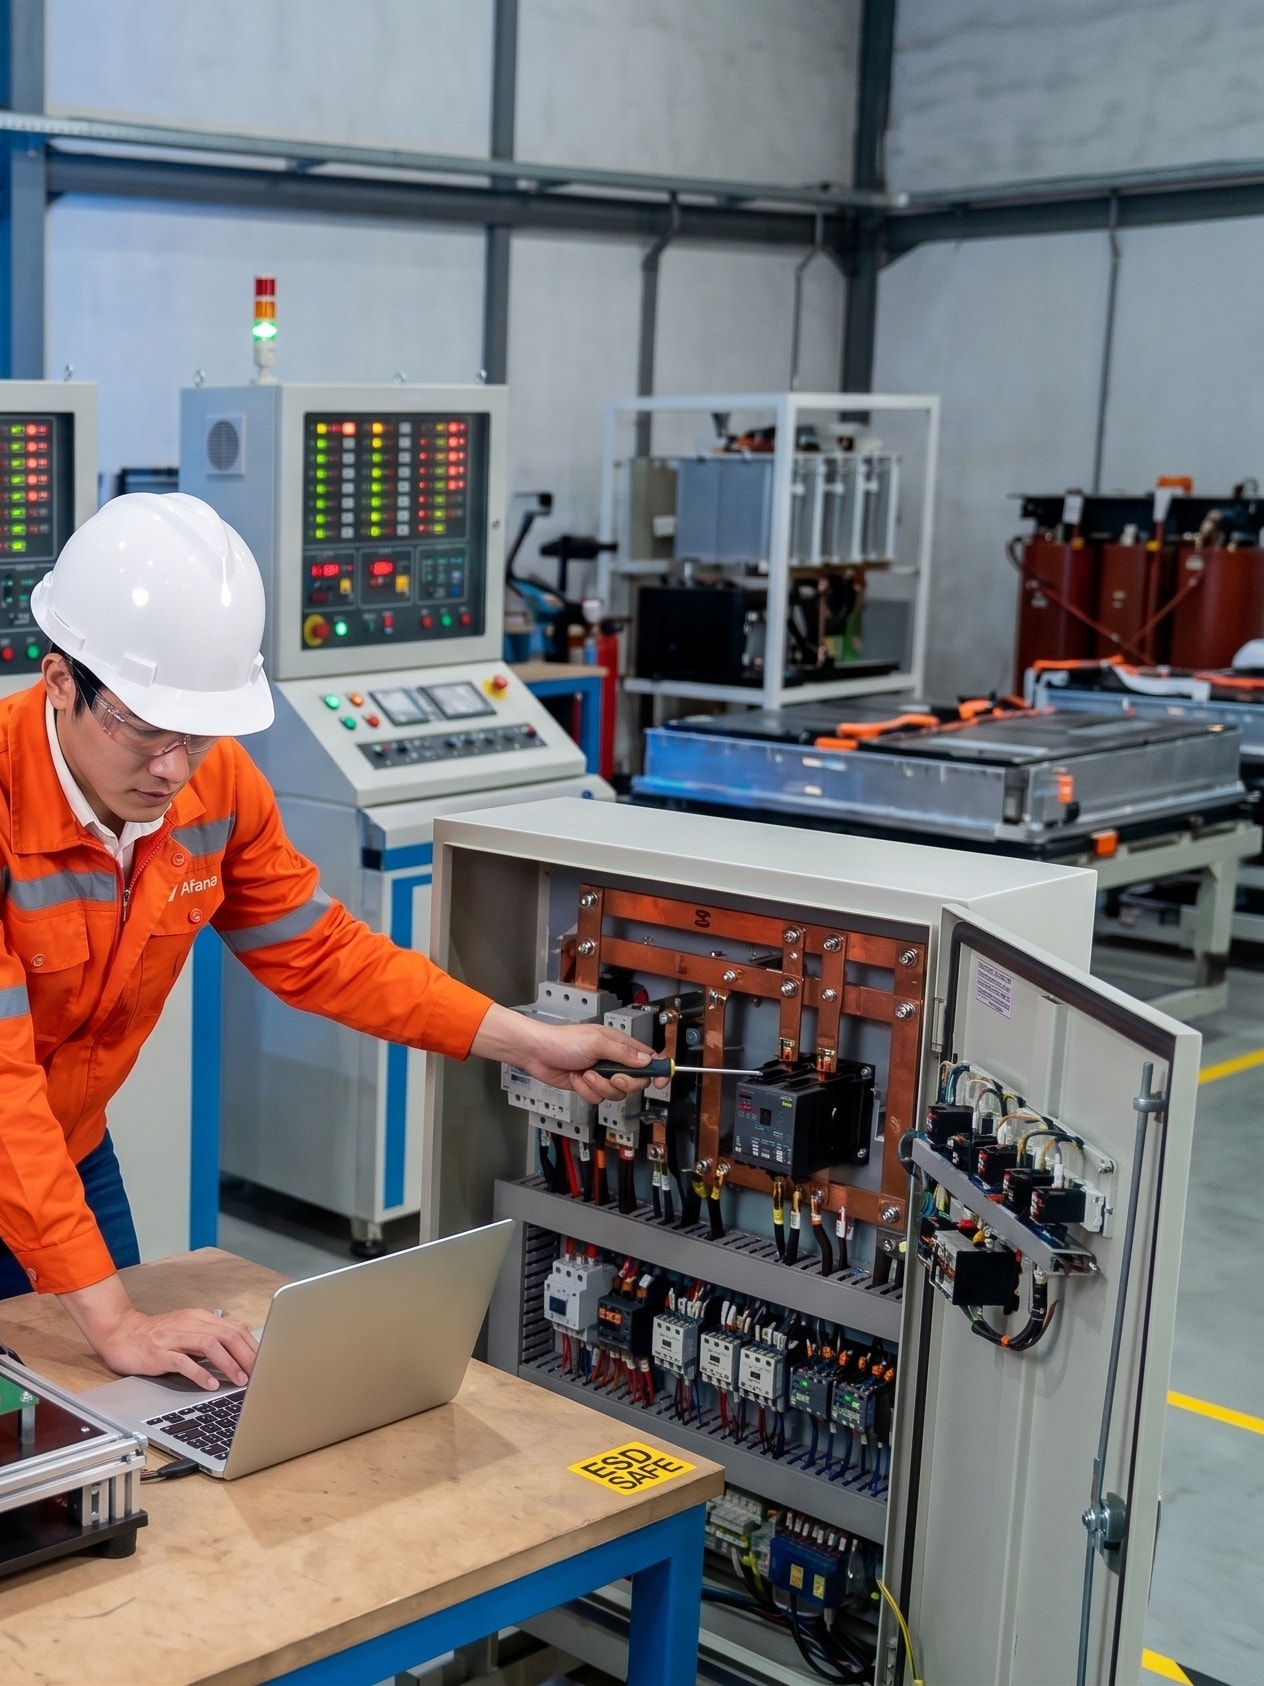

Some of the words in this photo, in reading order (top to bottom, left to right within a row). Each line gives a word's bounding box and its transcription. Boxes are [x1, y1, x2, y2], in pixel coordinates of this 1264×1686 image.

[180, 875, 218, 897] Afana
[580, 1448, 652, 1479] ESD
[608, 1457, 685, 1490] SAFE
